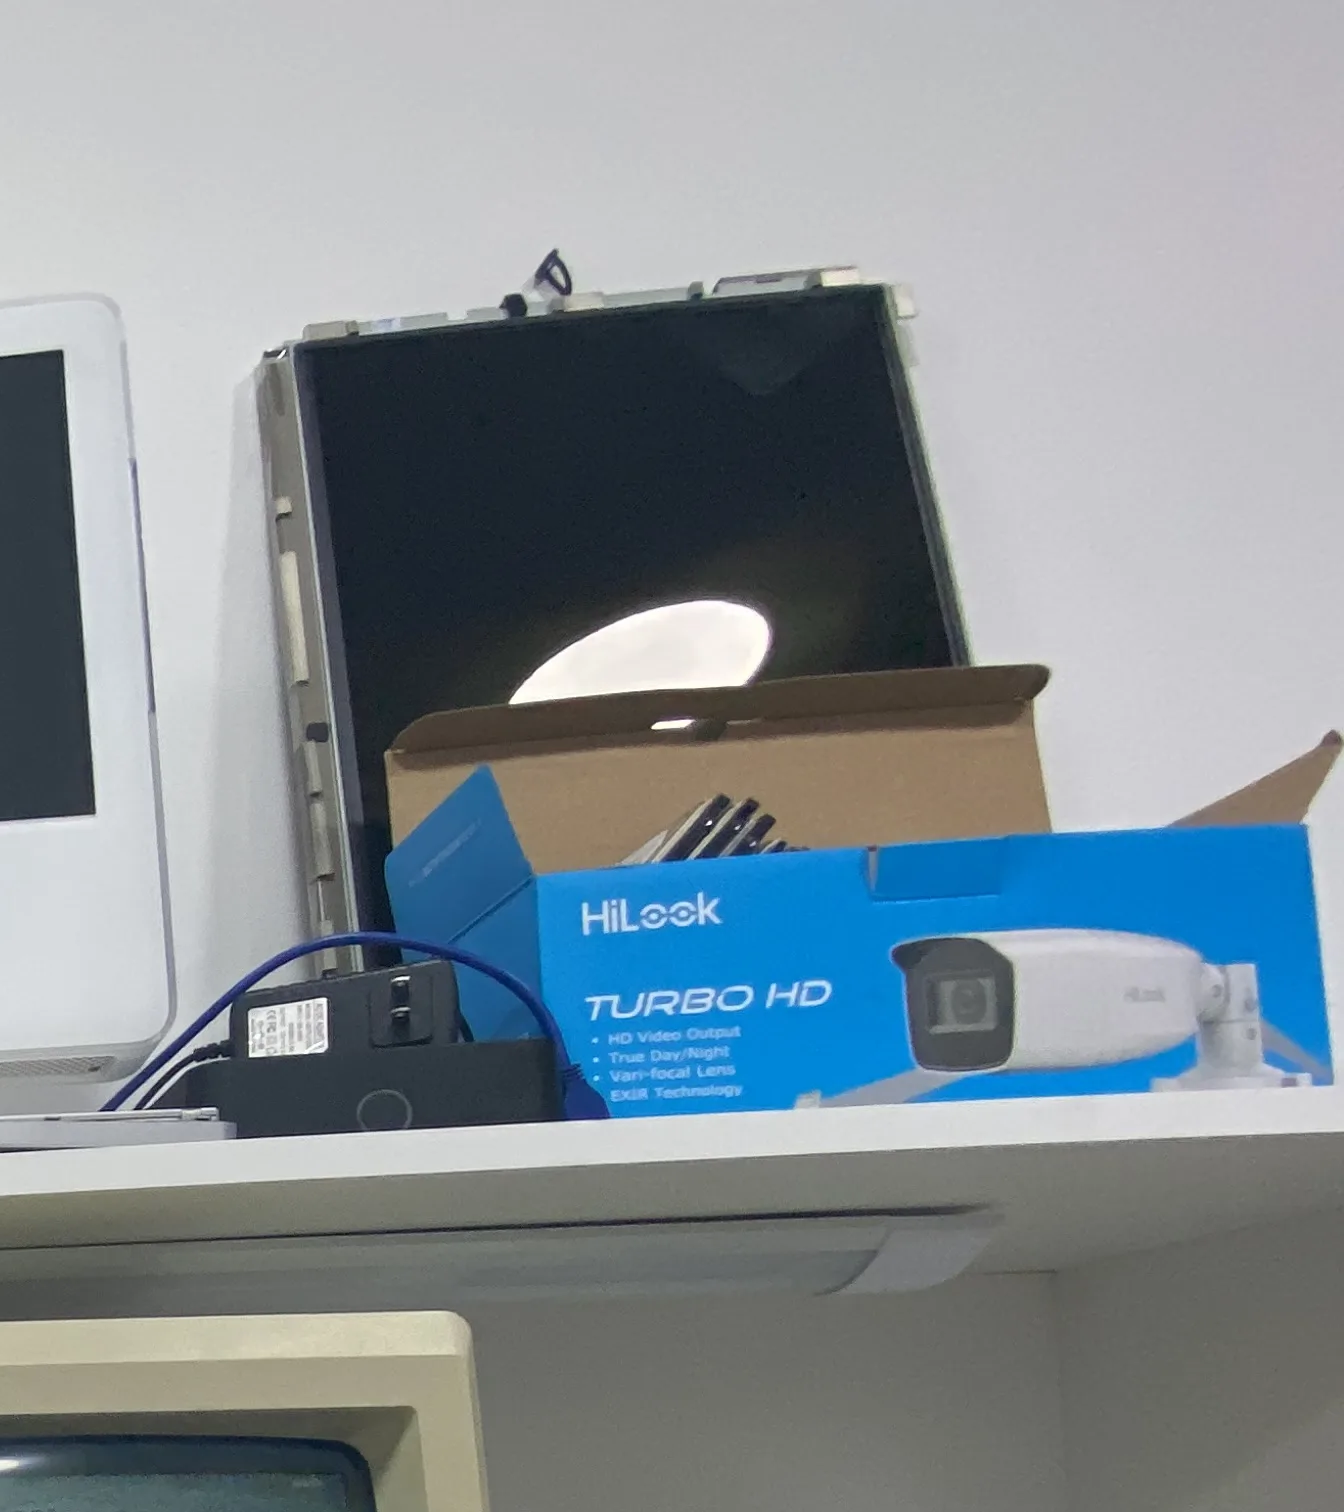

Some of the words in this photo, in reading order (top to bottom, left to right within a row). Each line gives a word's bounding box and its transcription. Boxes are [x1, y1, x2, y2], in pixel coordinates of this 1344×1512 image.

[582, 891, 723, 935] HiLook
[585, 985, 754, 1021] TURBO
[765, 980, 832, 1008] HD
[608, 1032, 632, 1045] HD
[637, 1029, 681, 1043] Video
[686, 1025, 742, 1041] Output
[609, 1051, 645, 1064] True
[650, 1045, 730, 1064] Day/Night
[609, 1066, 690, 1082] Vari-focal
[696, 1064, 736, 1077] Lens
[655, 1084, 743, 1099] Technology
